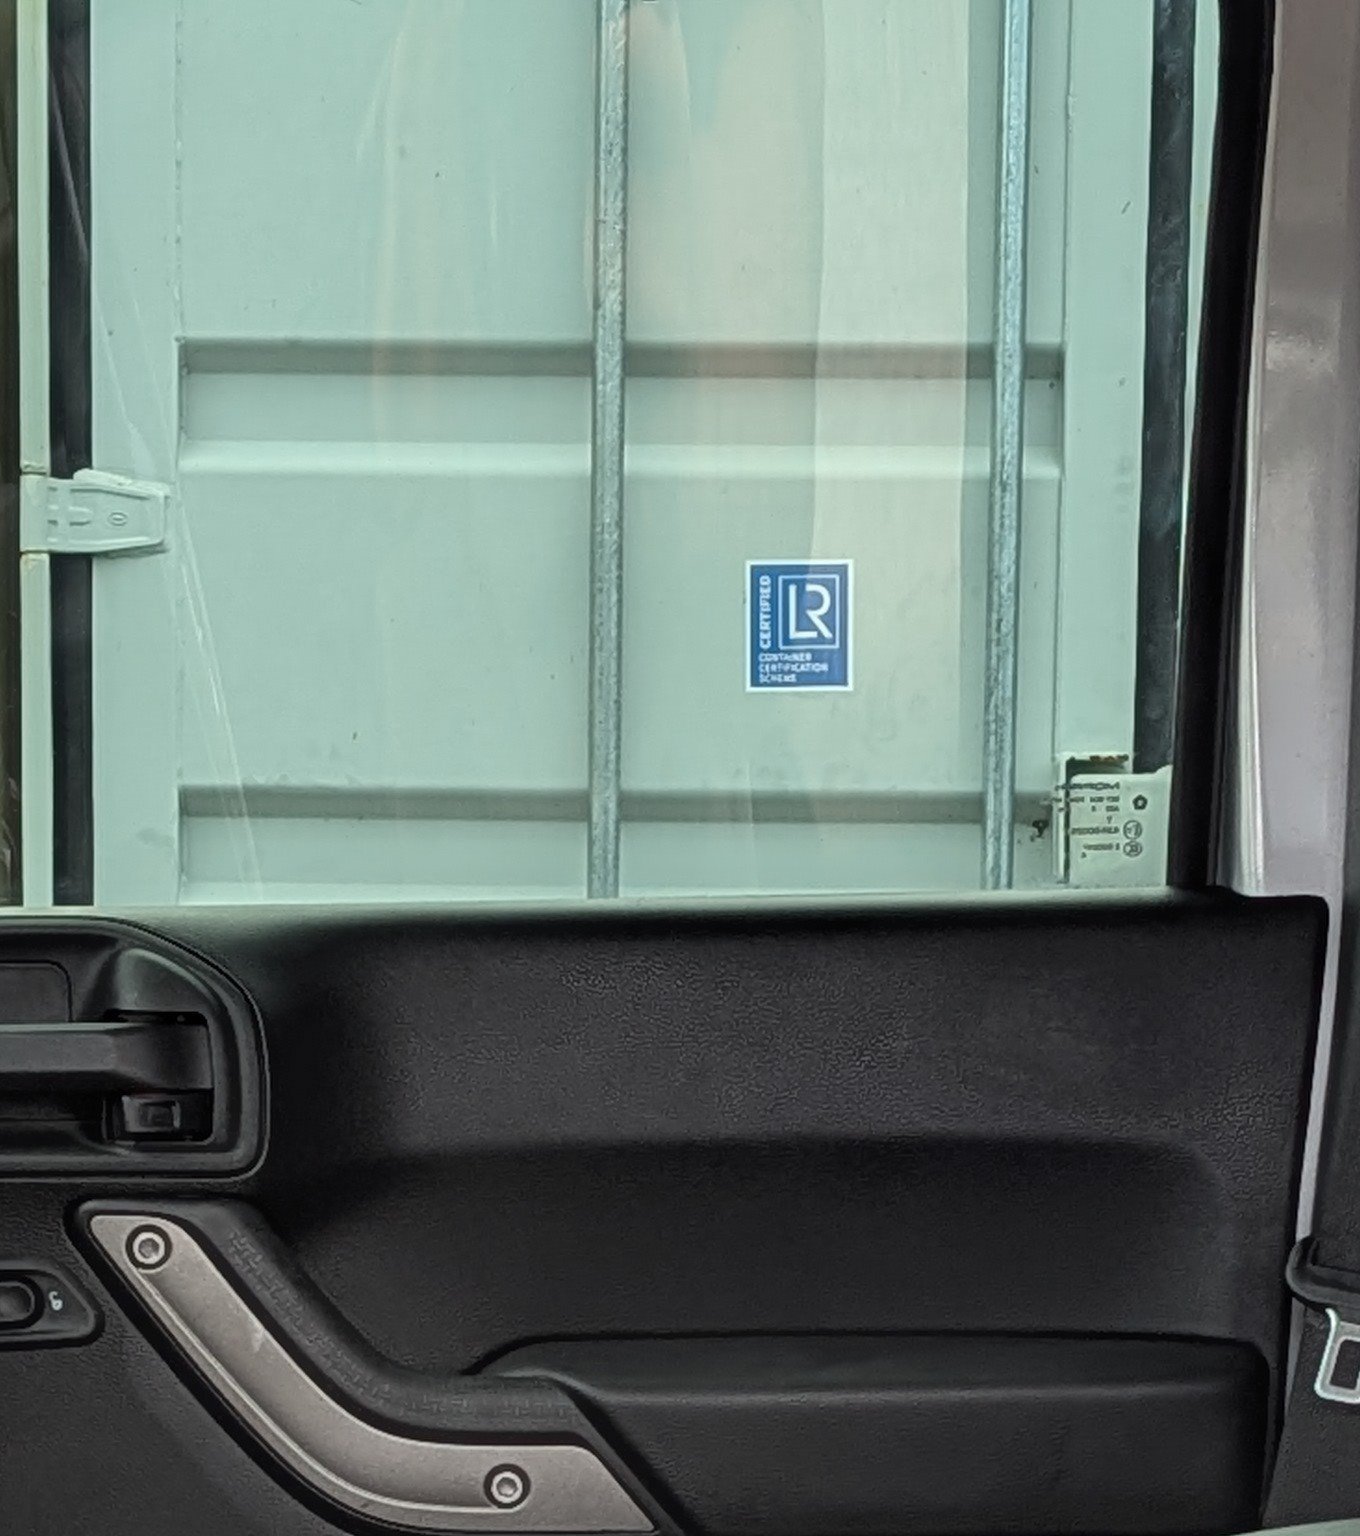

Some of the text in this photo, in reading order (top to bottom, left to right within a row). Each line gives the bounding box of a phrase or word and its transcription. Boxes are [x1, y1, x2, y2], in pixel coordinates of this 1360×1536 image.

[759, 575, 772, 650] CERTIFIED
[788, 583, 833, 639] LR
[758, 662, 829, 673] CERTIFICATION
